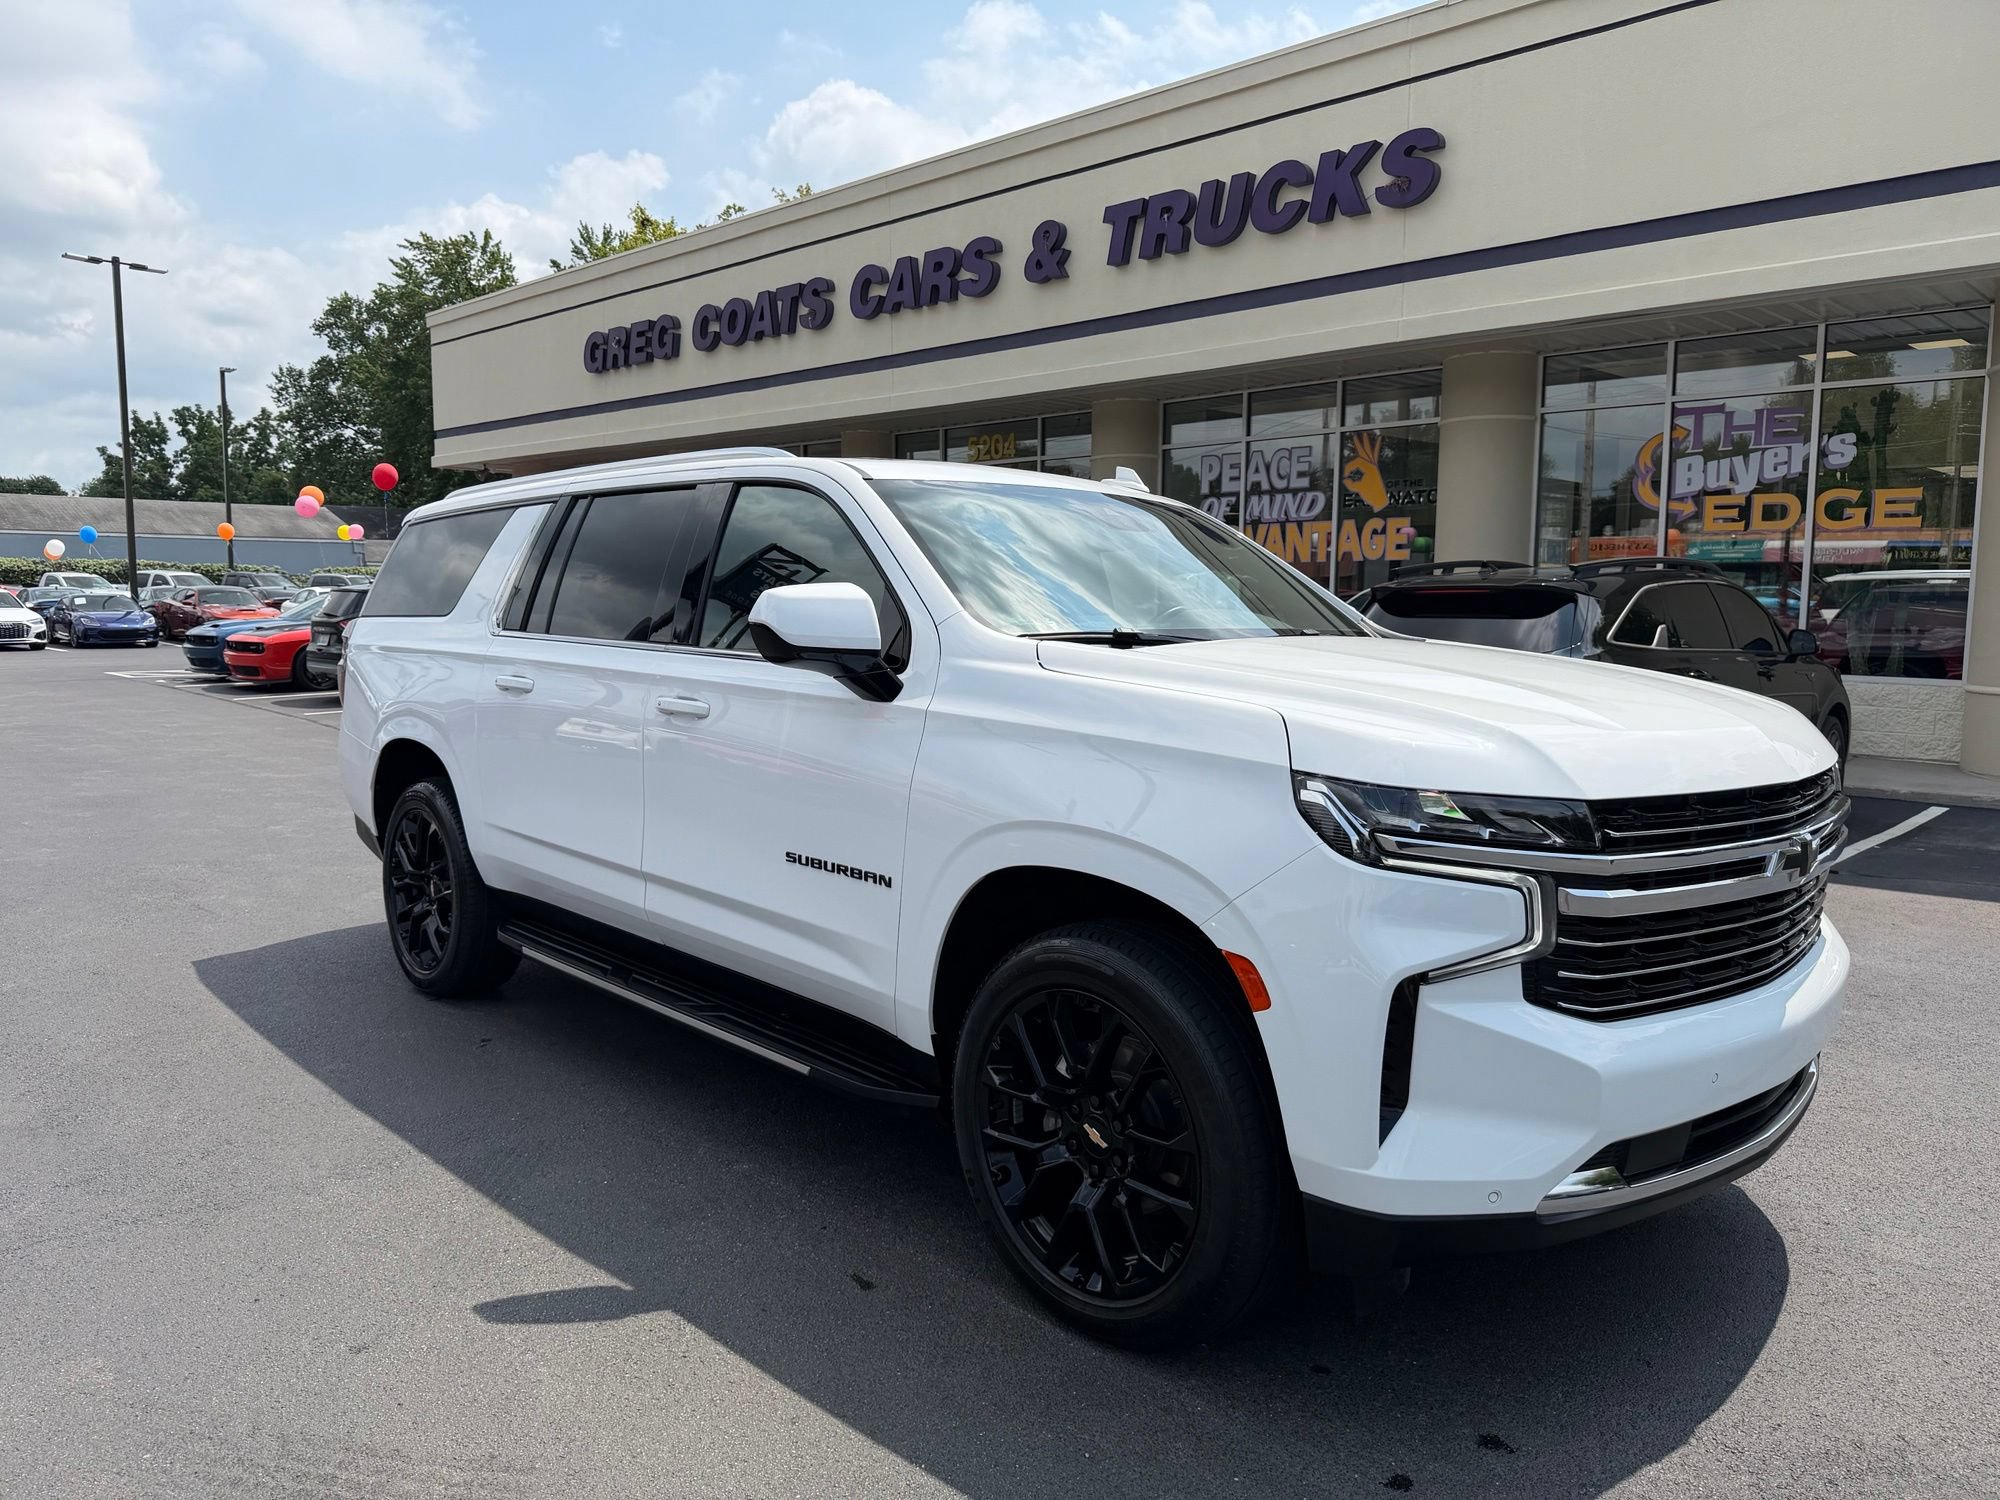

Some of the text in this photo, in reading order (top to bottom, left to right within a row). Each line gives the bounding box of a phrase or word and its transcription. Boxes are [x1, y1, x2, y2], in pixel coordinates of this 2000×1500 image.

[584, 127, 1446, 374] GREG COATS CARS & TRUCKS
[967, 432, 1016, 462] 5204
[1673, 402, 1809, 452] THE
[1200, 446, 1312, 495] PEACE
[1402, 478, 1425, 488] THE
[1671, 432, 1858, 499] Buyer's
[1201, 491, 1326, 523] OF MIND
[1702, 486, 1924, 532] EDGE
[1244, 517, 1411, 563] VANTAGE
[785, 851, 892, 888] SUBURBAN
